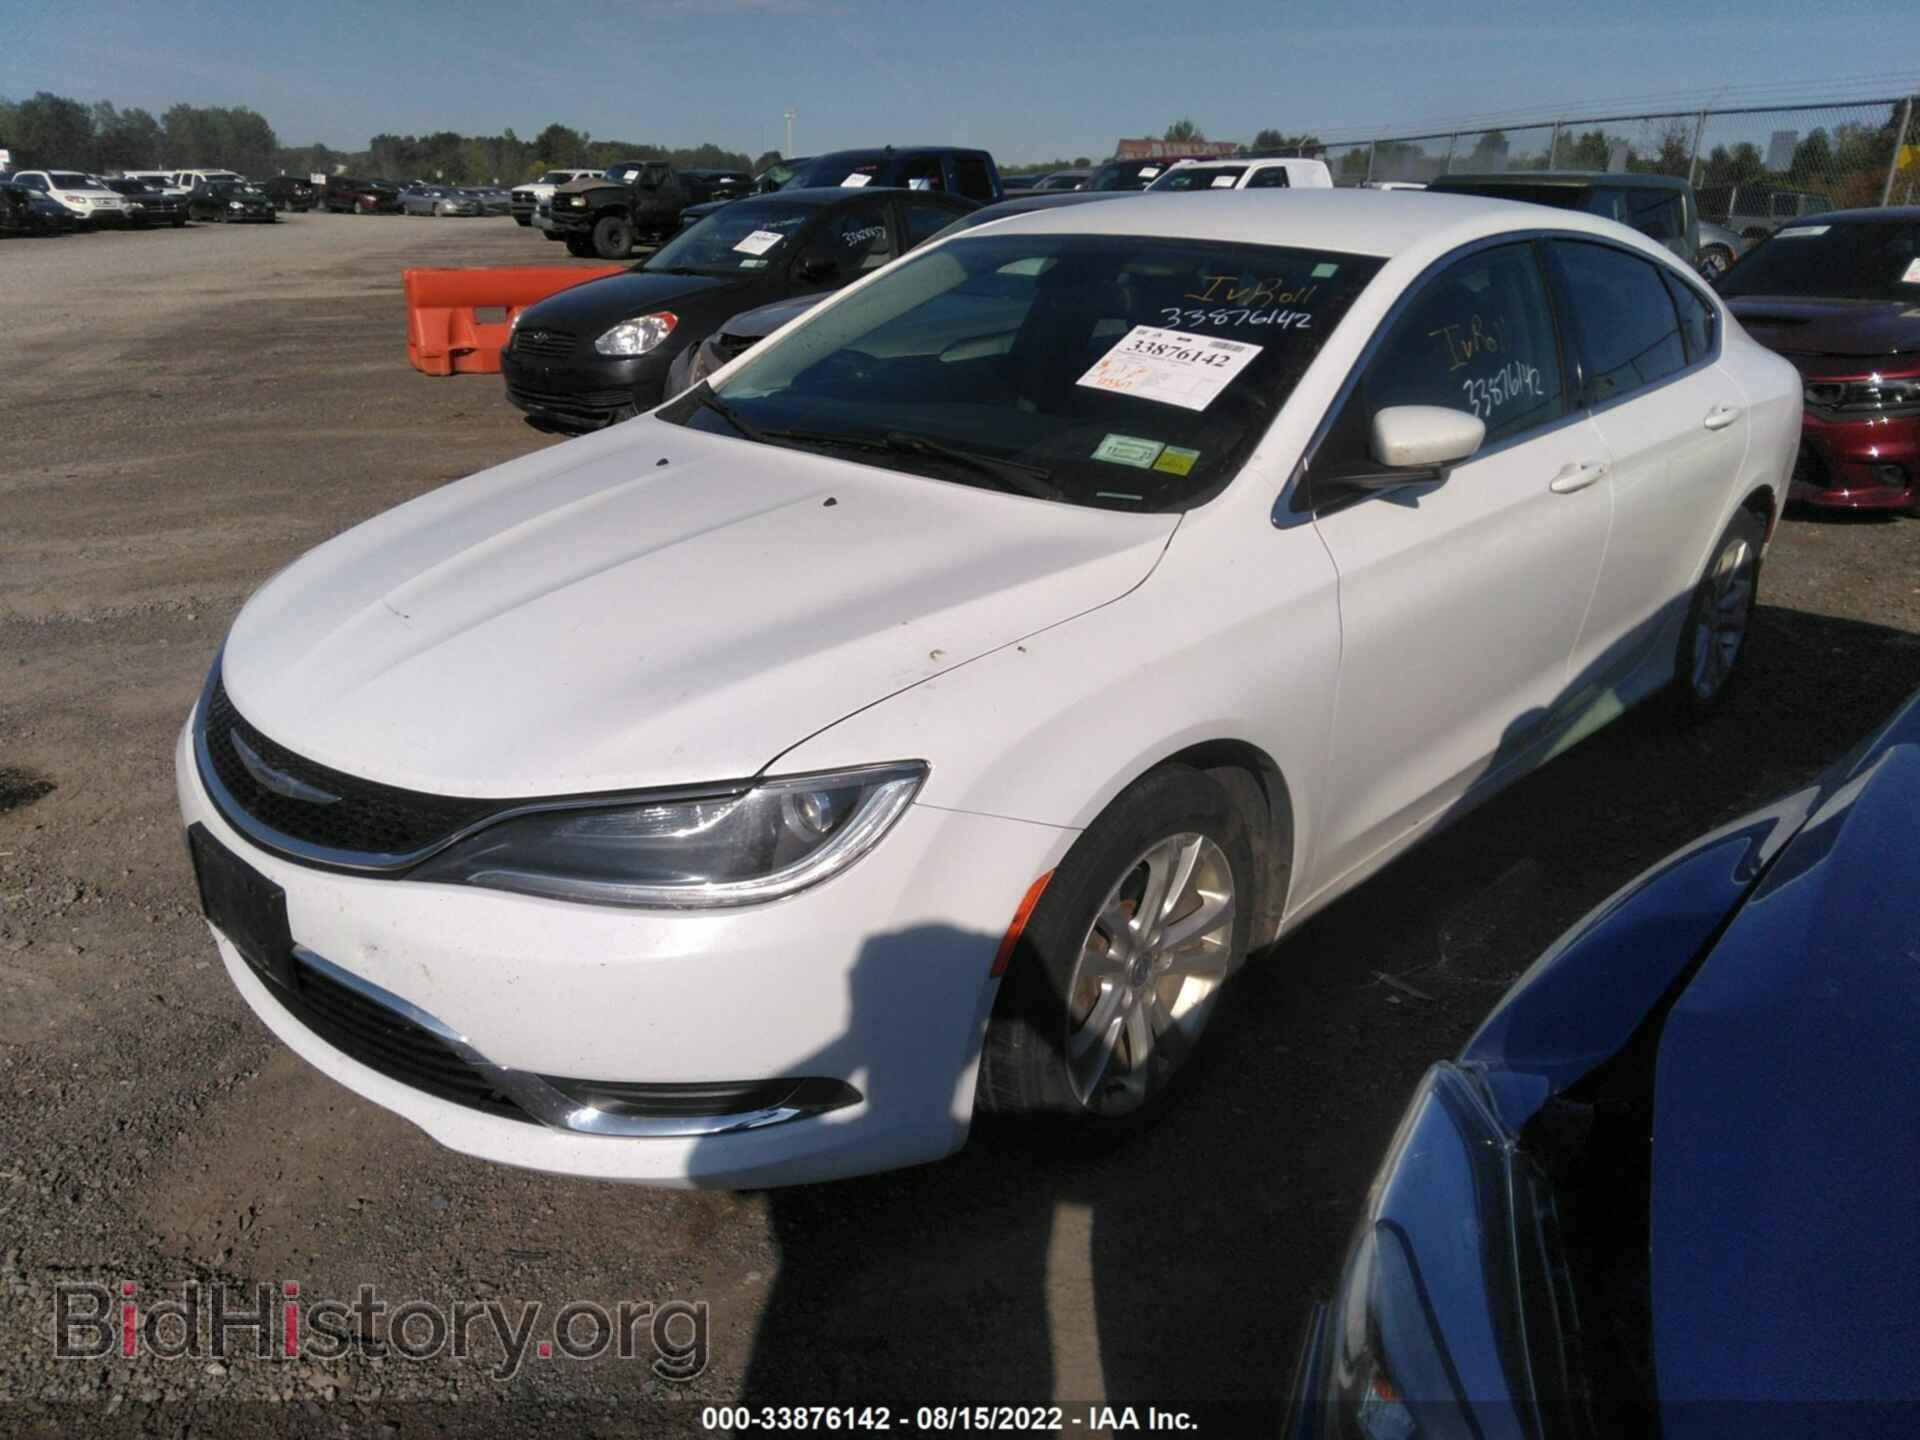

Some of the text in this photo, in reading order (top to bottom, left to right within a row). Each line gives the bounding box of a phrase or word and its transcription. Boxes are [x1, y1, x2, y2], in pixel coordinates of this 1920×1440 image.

[1160, 307, 1313, 329] 33876142
[1126, 340, 1231, 368] 33876142
[1462, 360, 1544, 417] 33876142
